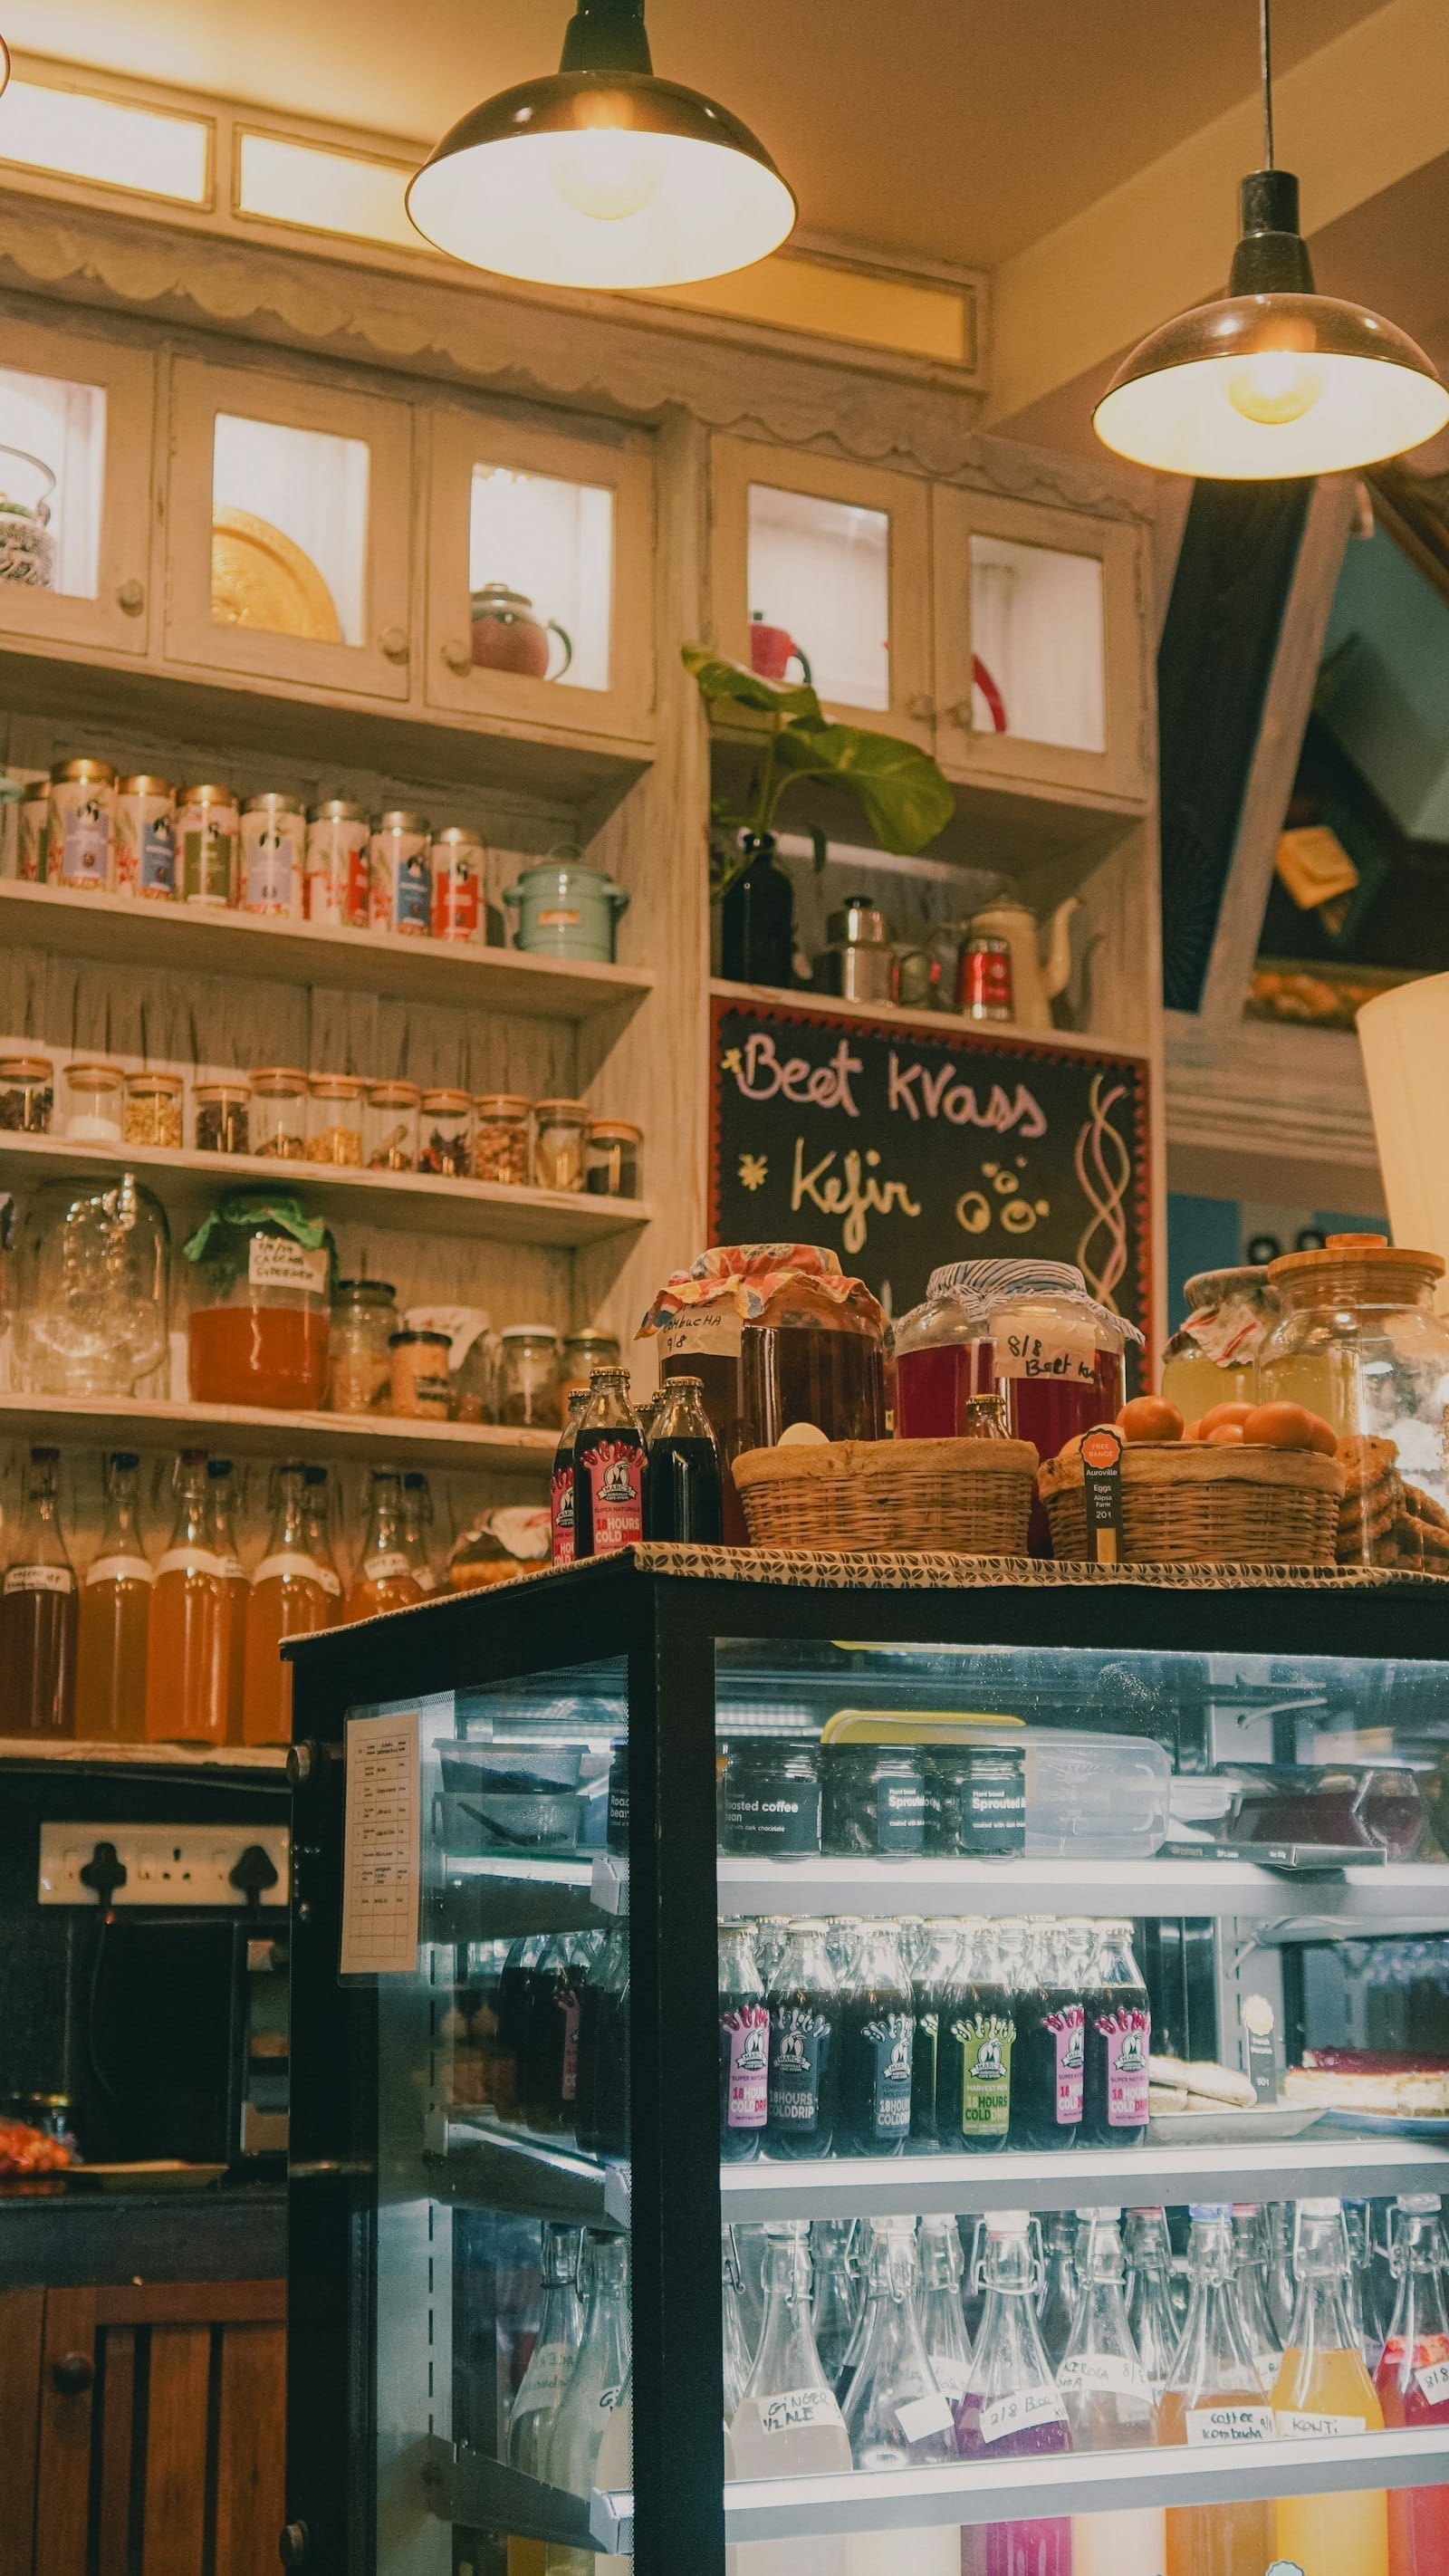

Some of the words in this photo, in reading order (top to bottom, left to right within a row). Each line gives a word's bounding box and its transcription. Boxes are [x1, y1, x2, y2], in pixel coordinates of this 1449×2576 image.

[737, 1033, 863, 1117] Beet
[792, 1136, 921, 1254] Kefir
[1007, 1335, 1042, 1358] 8/8
[1086, 1469, 1118, 1477] Auroville
[1093, 1485, 1111, 1494] Eggs
[762, 1800, 799, 1812] coffee
[973, 1797, 1020, 1812] Sprouted
